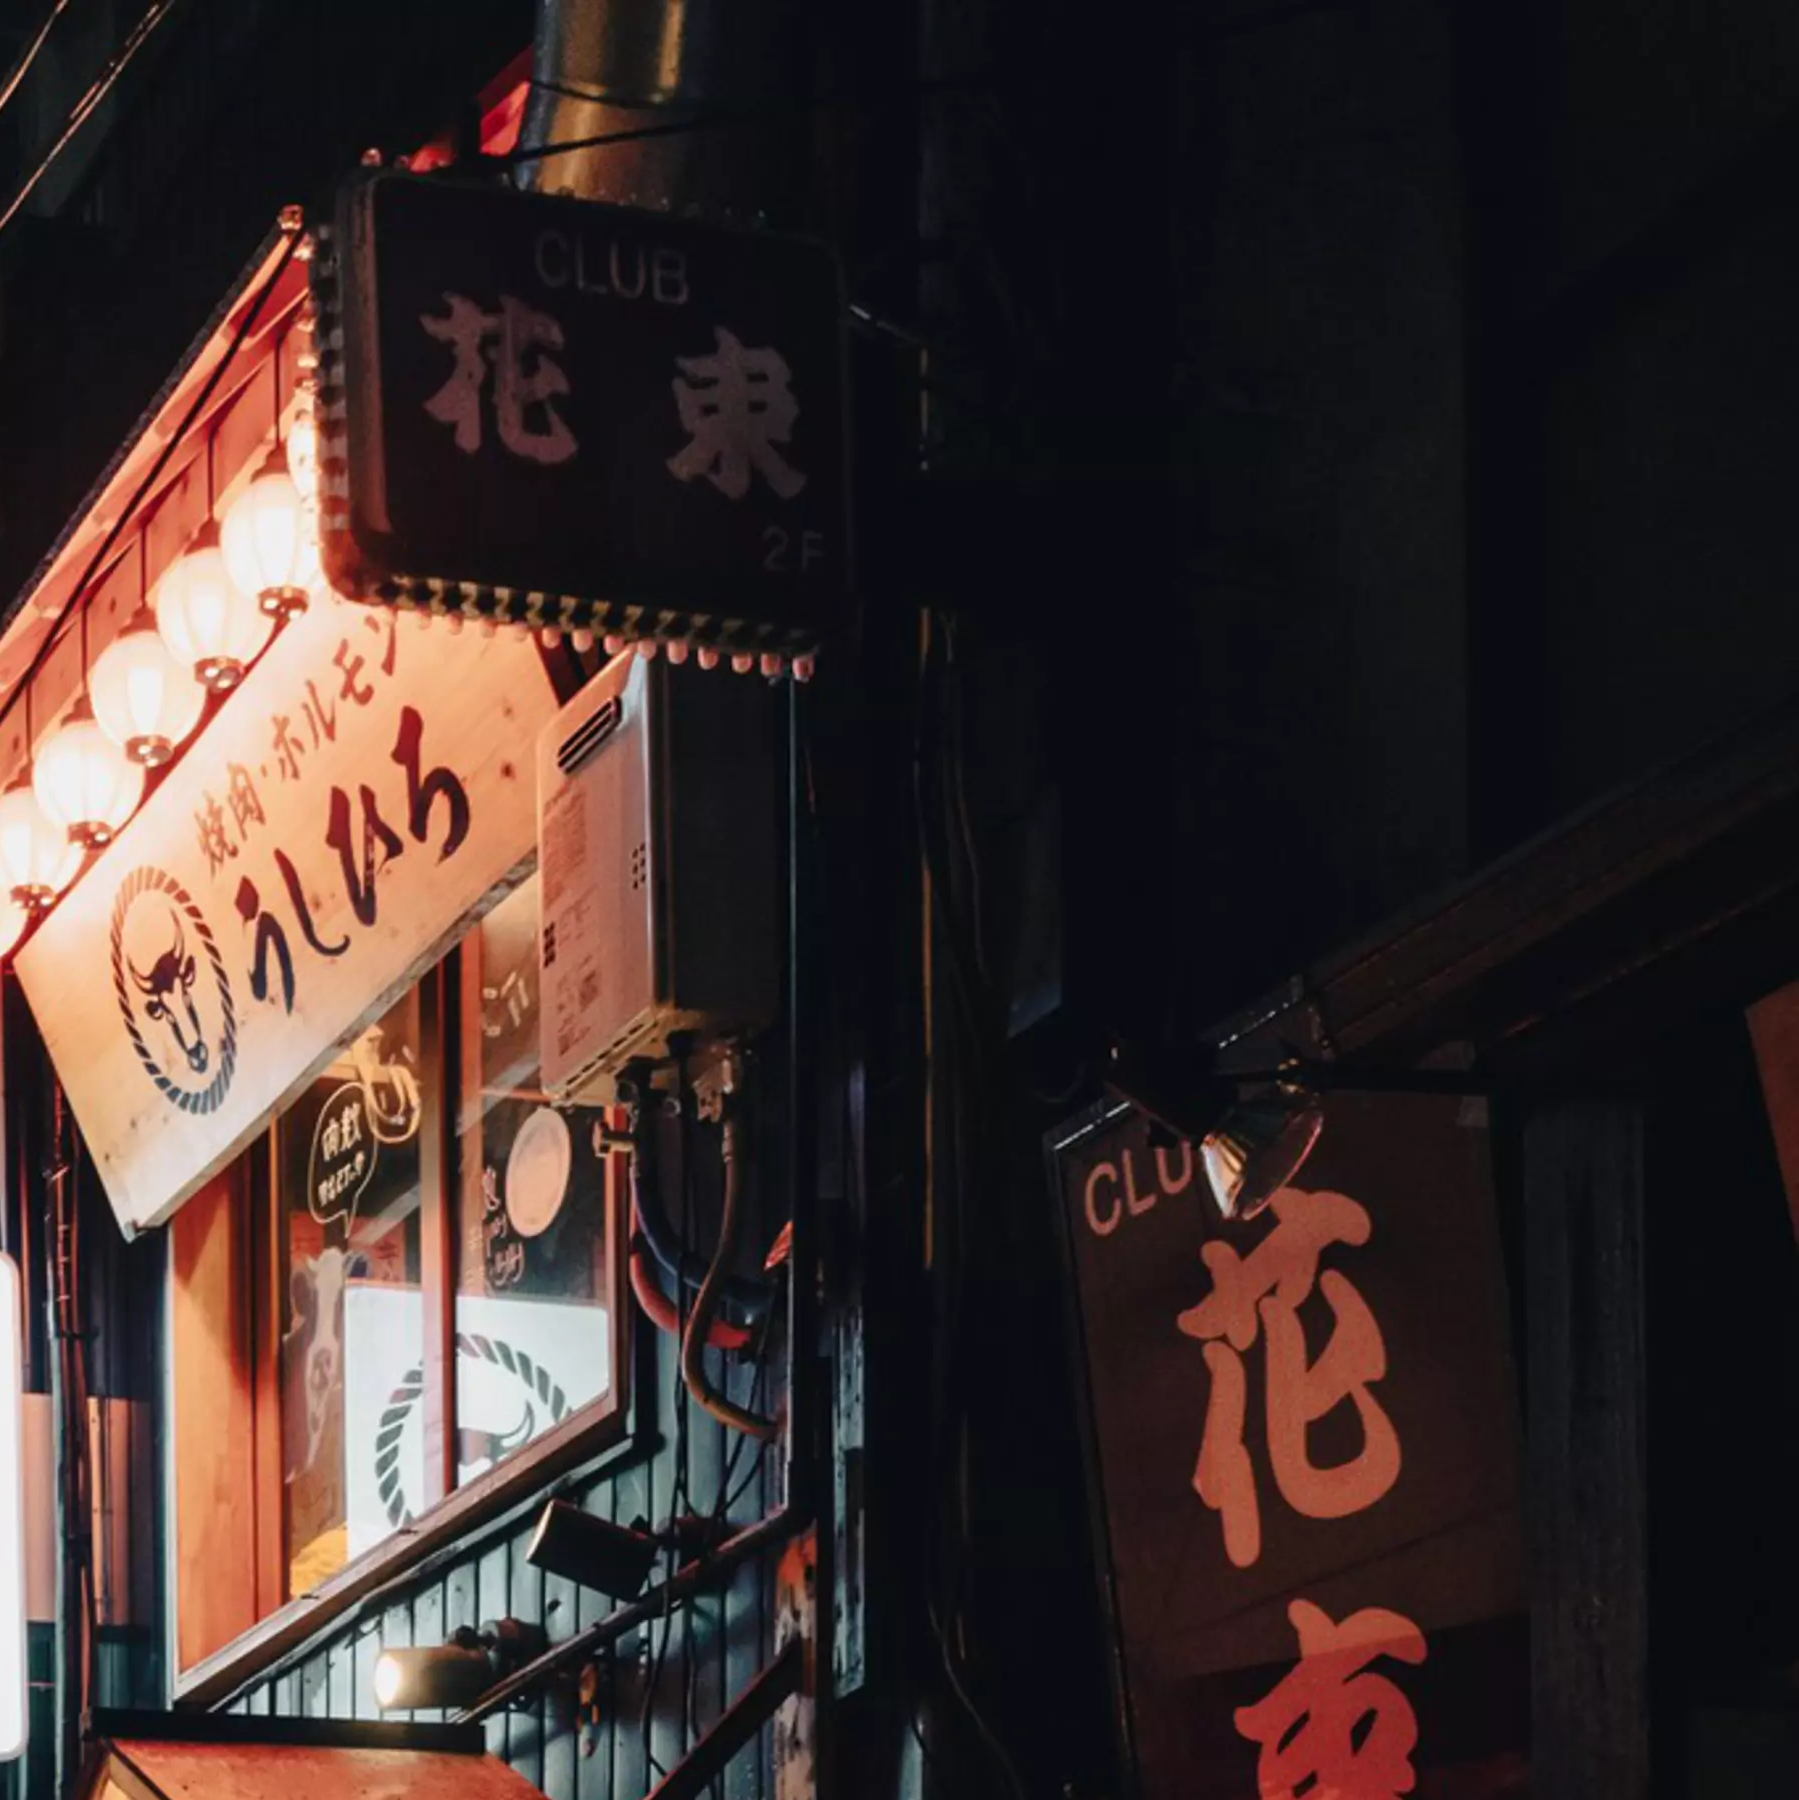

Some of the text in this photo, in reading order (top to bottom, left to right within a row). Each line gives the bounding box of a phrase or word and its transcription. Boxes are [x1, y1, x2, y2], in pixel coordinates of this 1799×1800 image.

[535, 230, 691, 306] CLUB
[761, 526, 826, 572] 2F
[235, 705, 471, 1016] うしひろ
[1084, 1137, 1194, 1236] CLU
